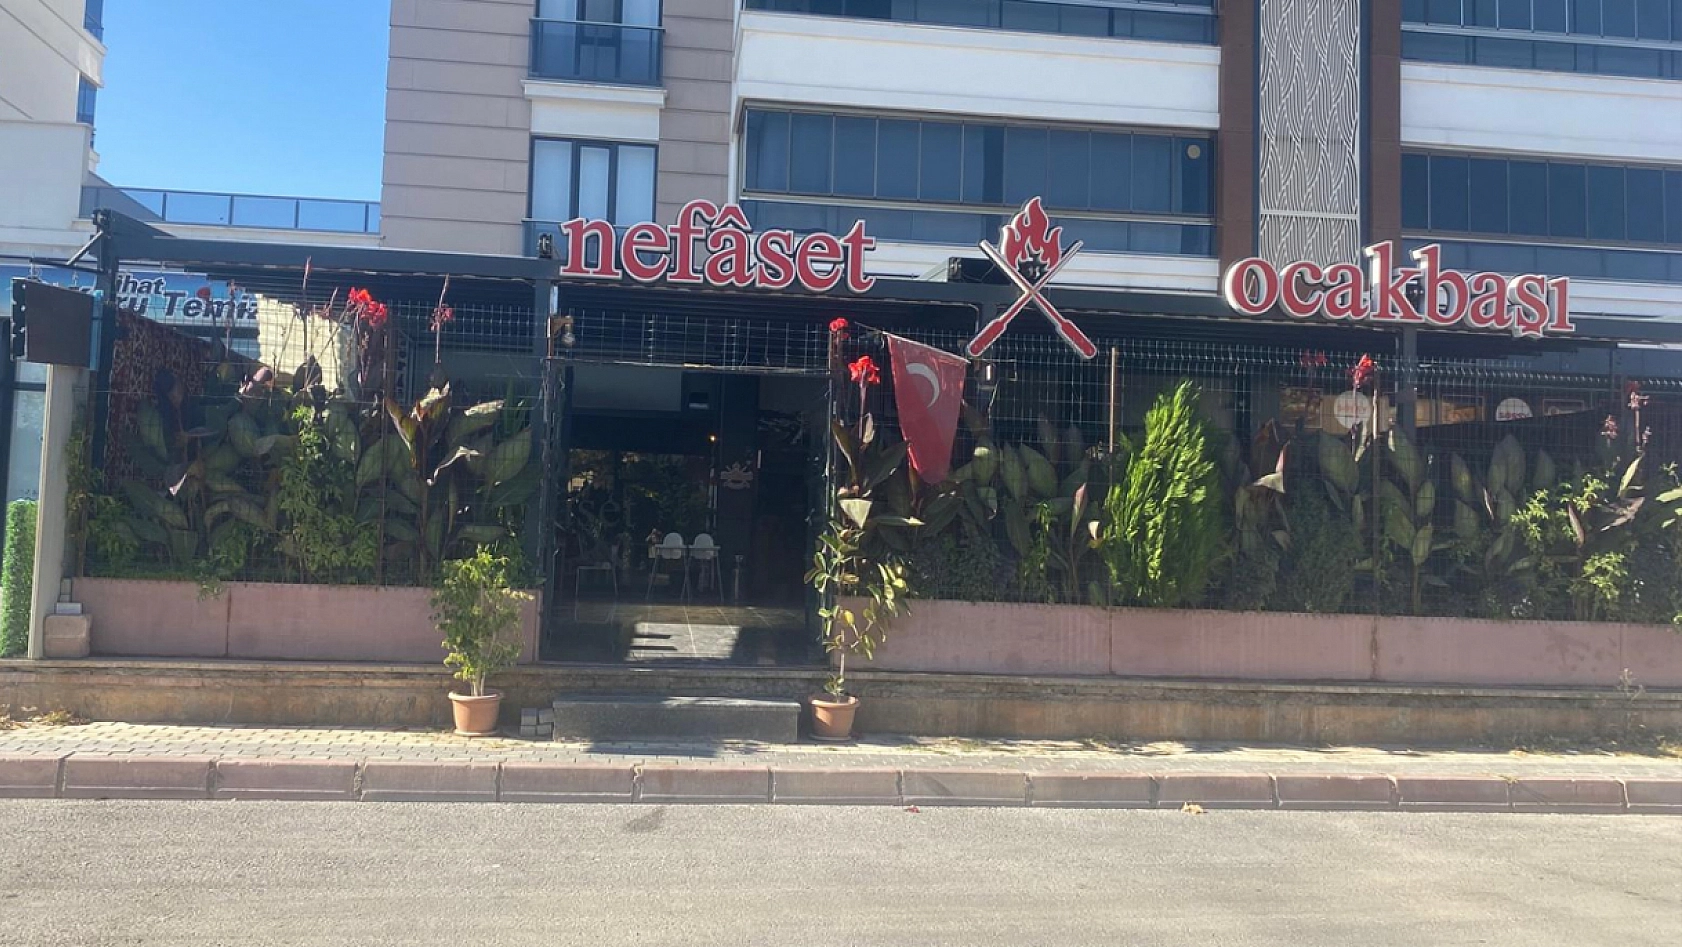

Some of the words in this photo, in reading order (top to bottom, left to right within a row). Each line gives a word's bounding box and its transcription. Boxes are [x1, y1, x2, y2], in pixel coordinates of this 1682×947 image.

[115, 273, 166, 294] ihat
[559, 199, 877, 294] nefâset
[1224, 241, 1575, 338] ocakbaşı
